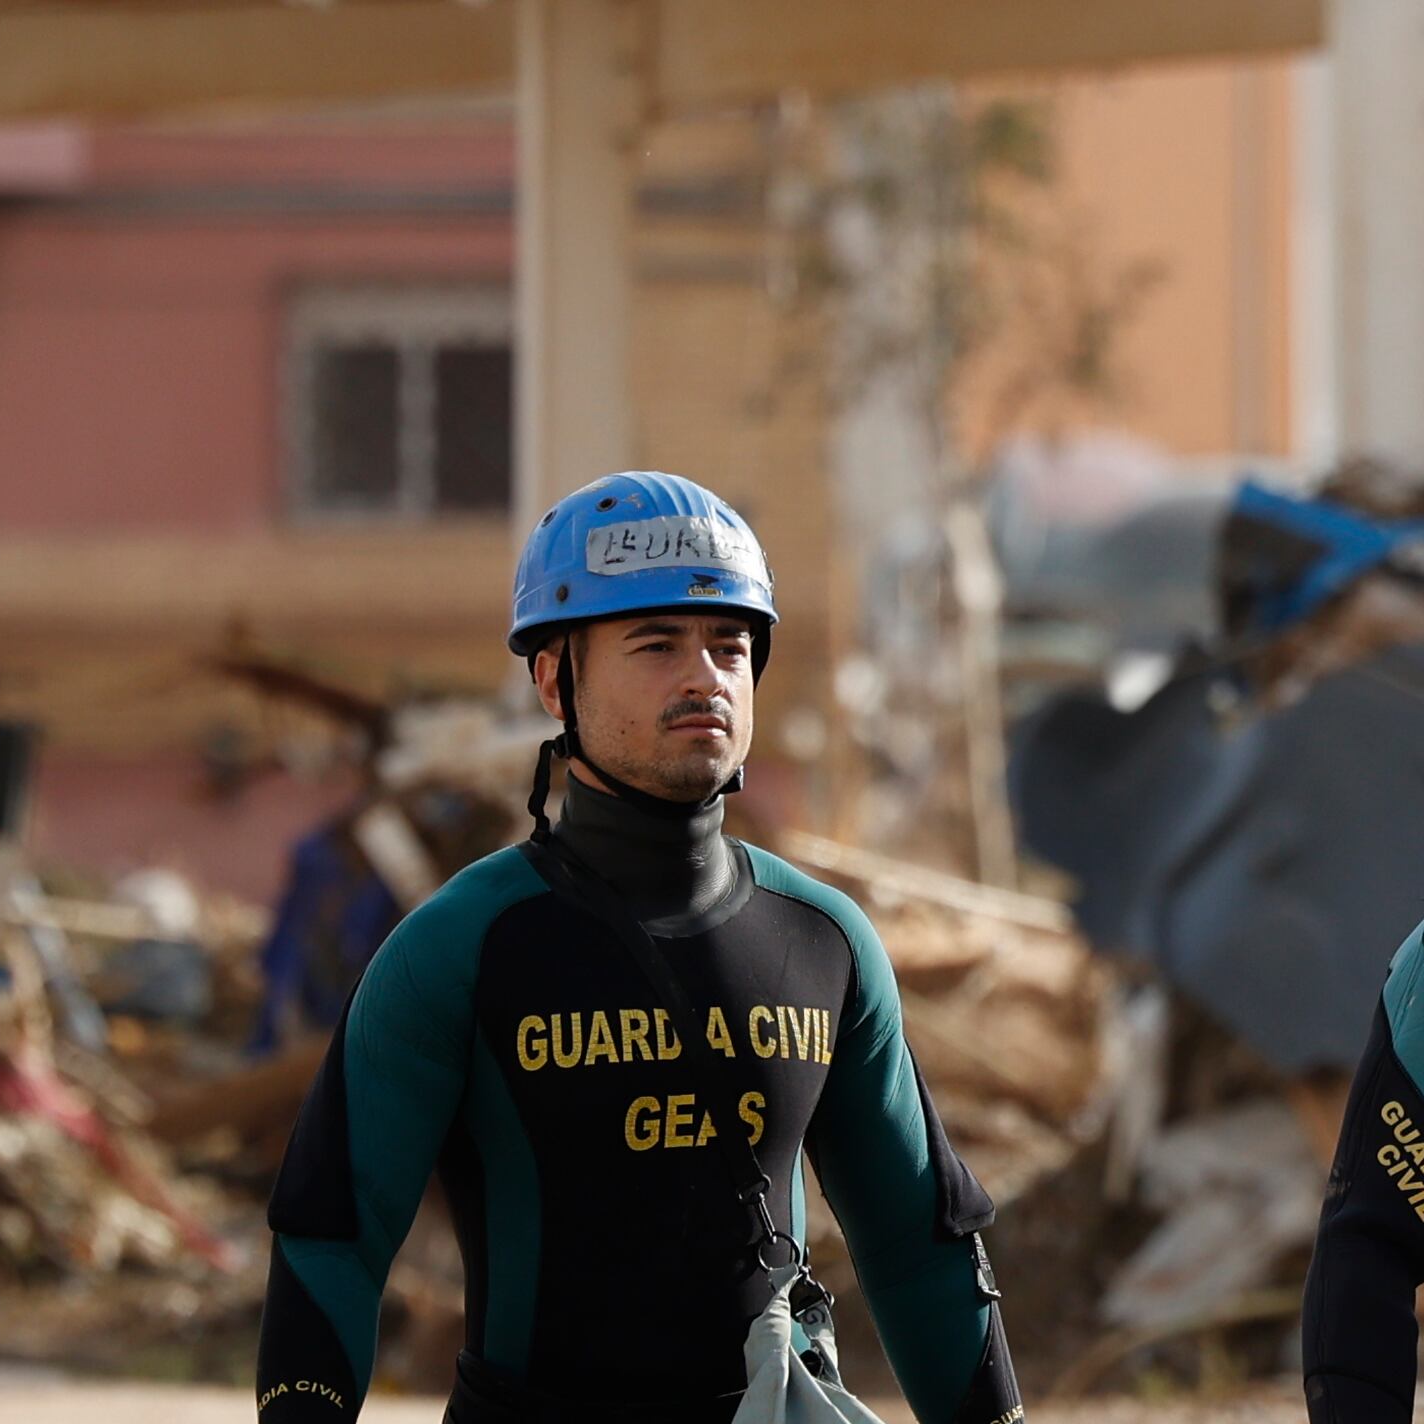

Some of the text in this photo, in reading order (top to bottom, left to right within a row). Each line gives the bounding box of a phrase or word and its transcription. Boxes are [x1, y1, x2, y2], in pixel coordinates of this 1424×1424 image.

[516, 1004, 833, 1072] GUARDA CIVIL
[295, 1380, 343, 1409] CIVIL
